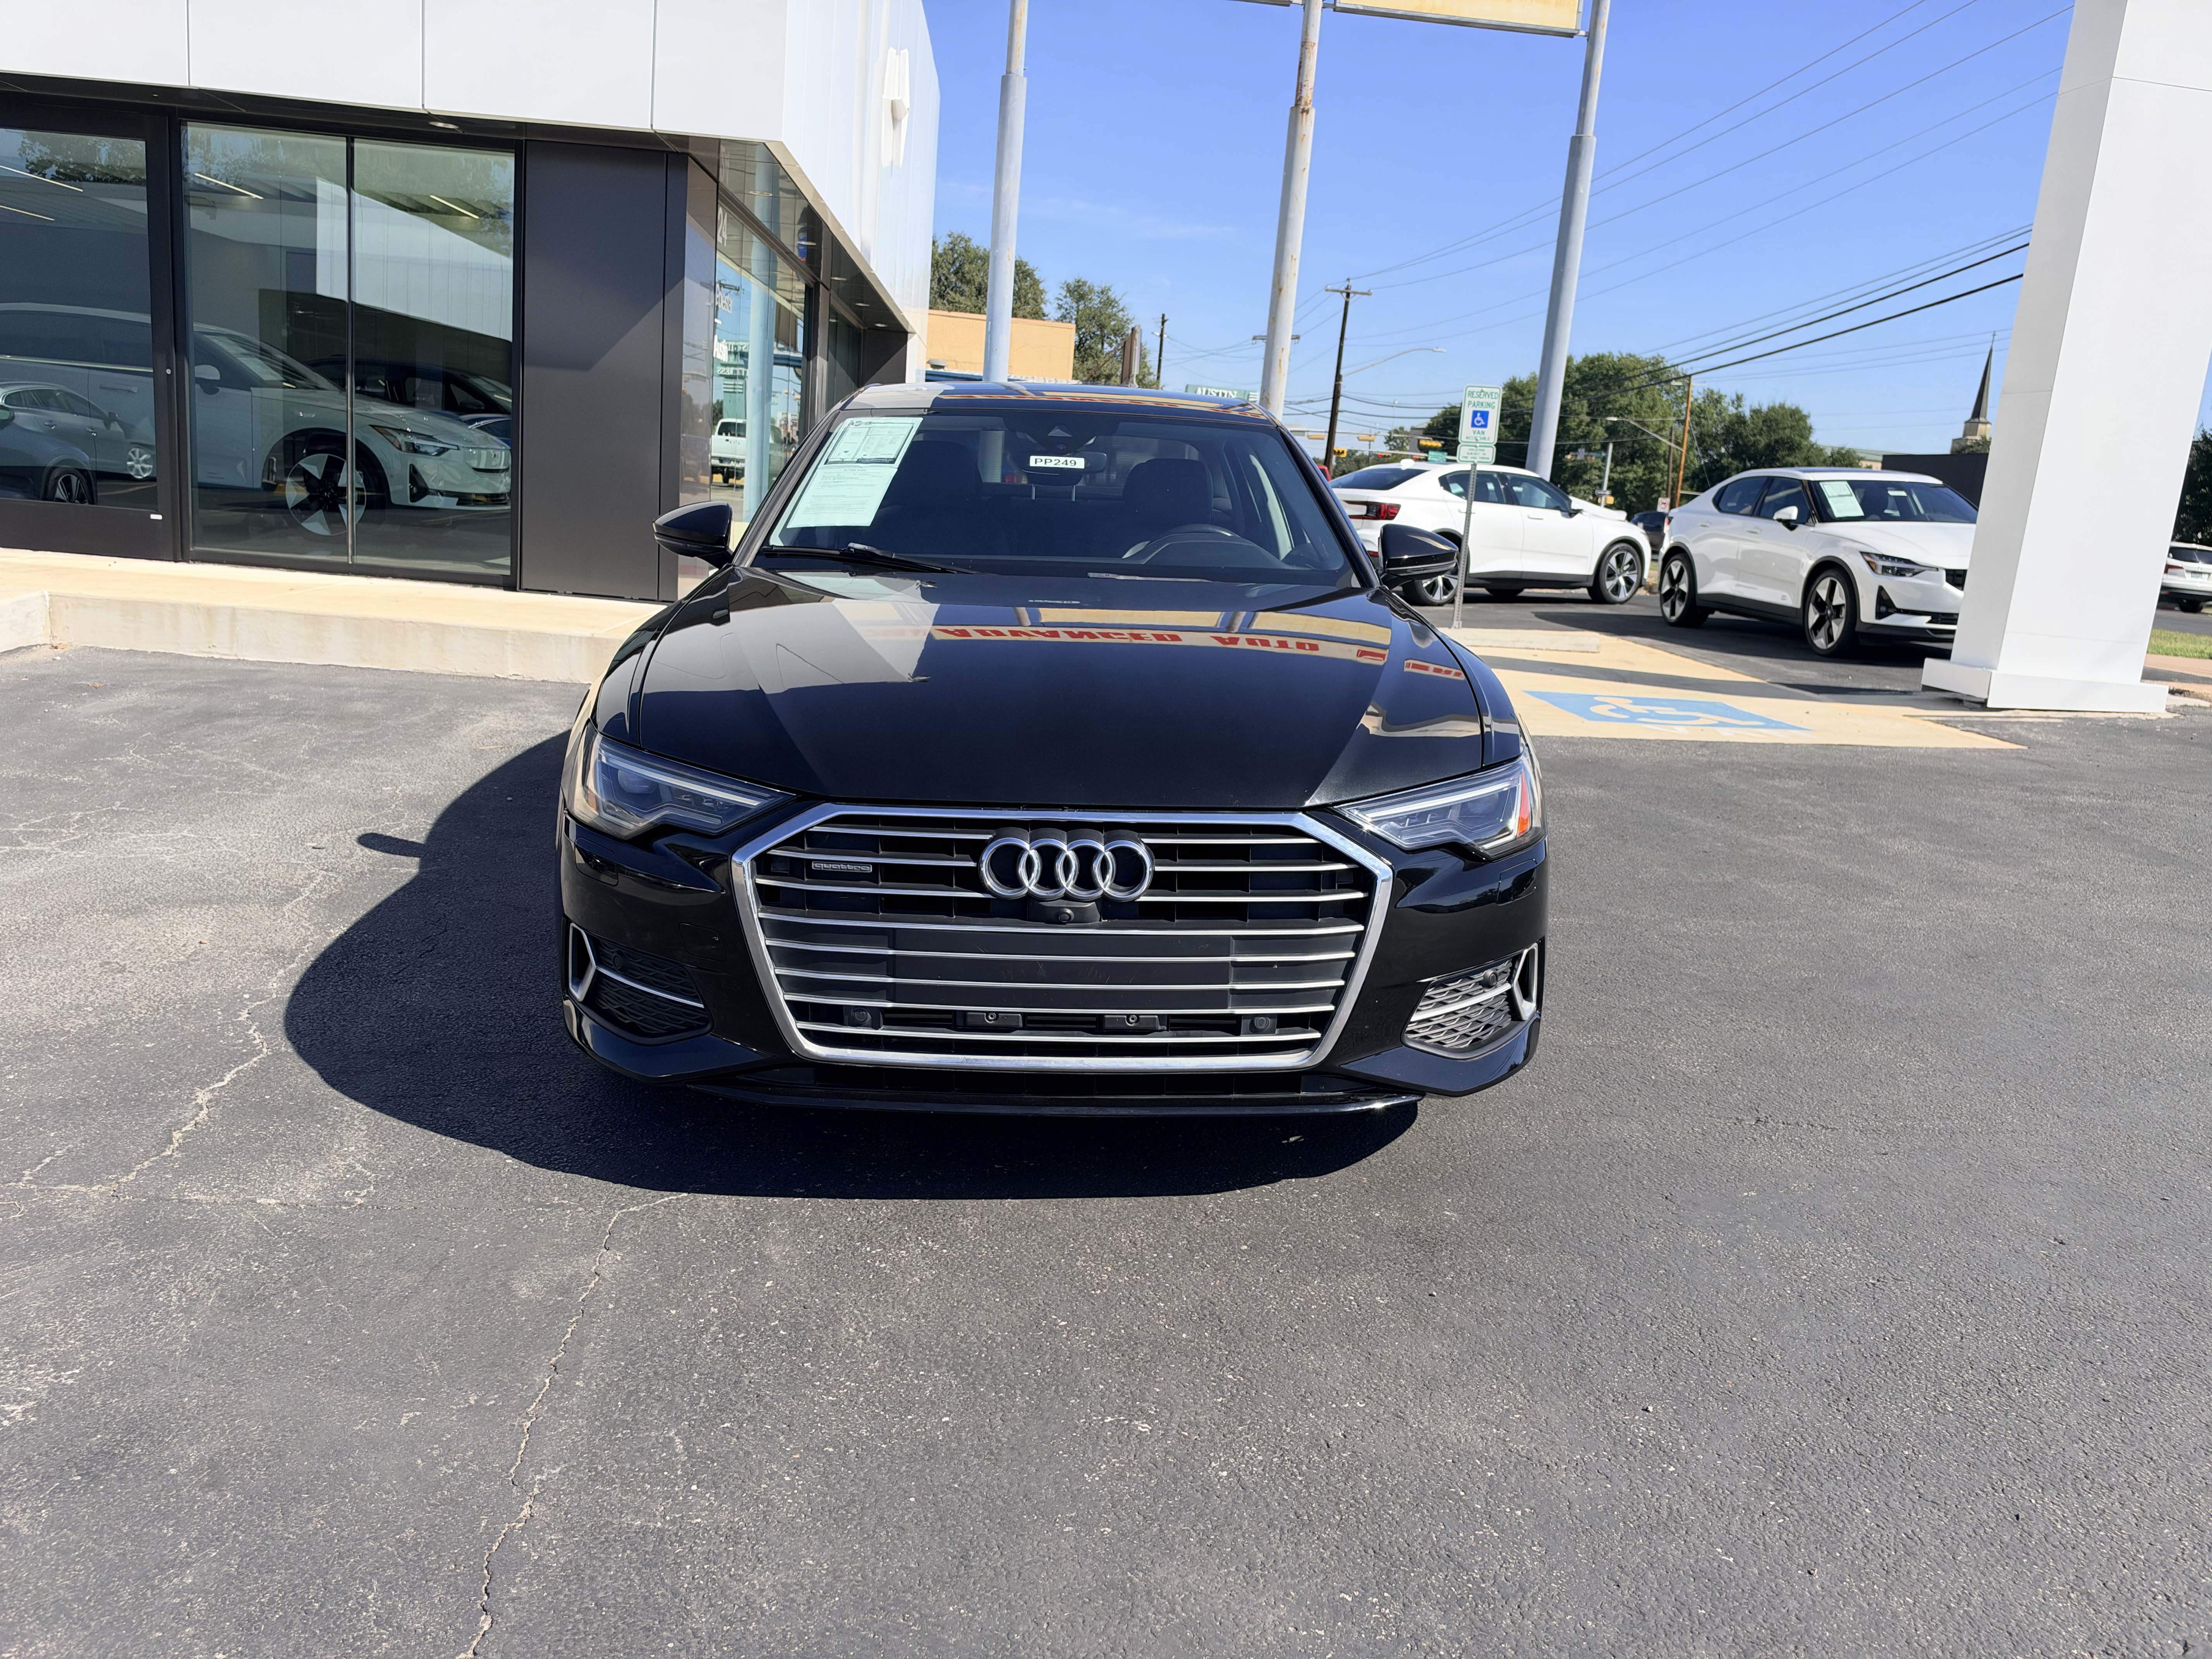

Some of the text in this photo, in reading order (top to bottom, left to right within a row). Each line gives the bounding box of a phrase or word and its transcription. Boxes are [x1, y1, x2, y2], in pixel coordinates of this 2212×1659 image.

[717, 206, 727, 247] 24
[713, 334, 728, 362] Austin
[1196, 387, 1237, 398] AUSTIN
[1467, 391, 1498, 399] RESERVED
[1468, 400, 1495, 409] PARKING
[1034, 458, 1077, 466] PP249
[814, 863, 869, 871] quattro
